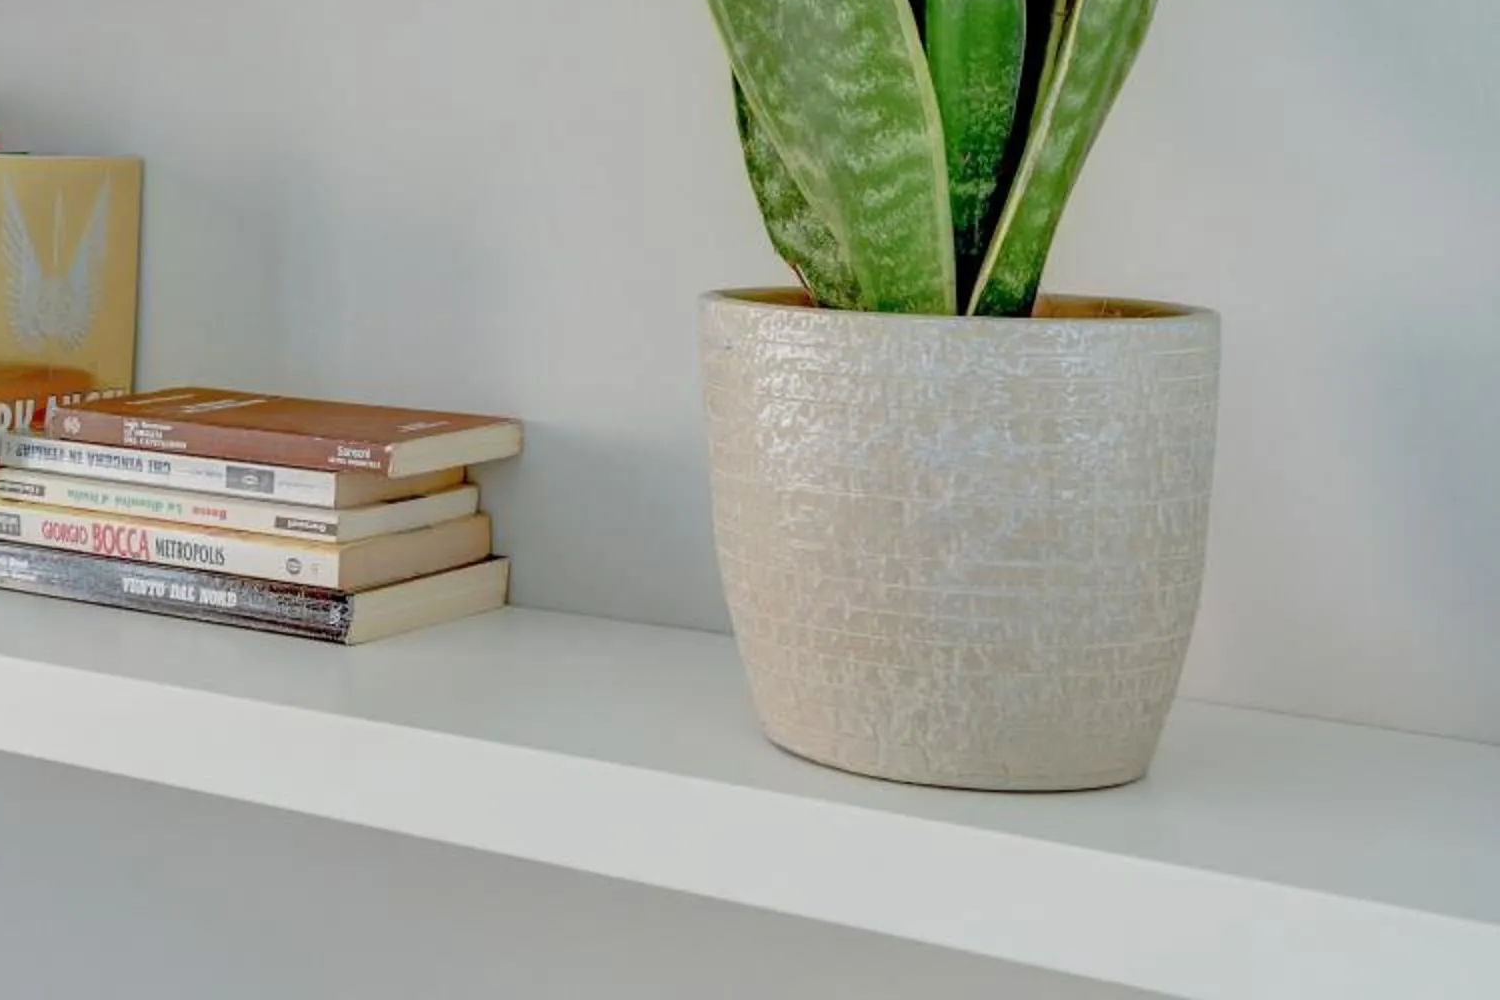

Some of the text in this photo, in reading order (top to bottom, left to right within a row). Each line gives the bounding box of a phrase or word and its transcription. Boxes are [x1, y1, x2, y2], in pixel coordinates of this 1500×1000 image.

[41, 520, 88, 545] GIORGIO
[91, 522, 151, 560] BOCCA
[154, 540, 225, 566] METROPOLIS
